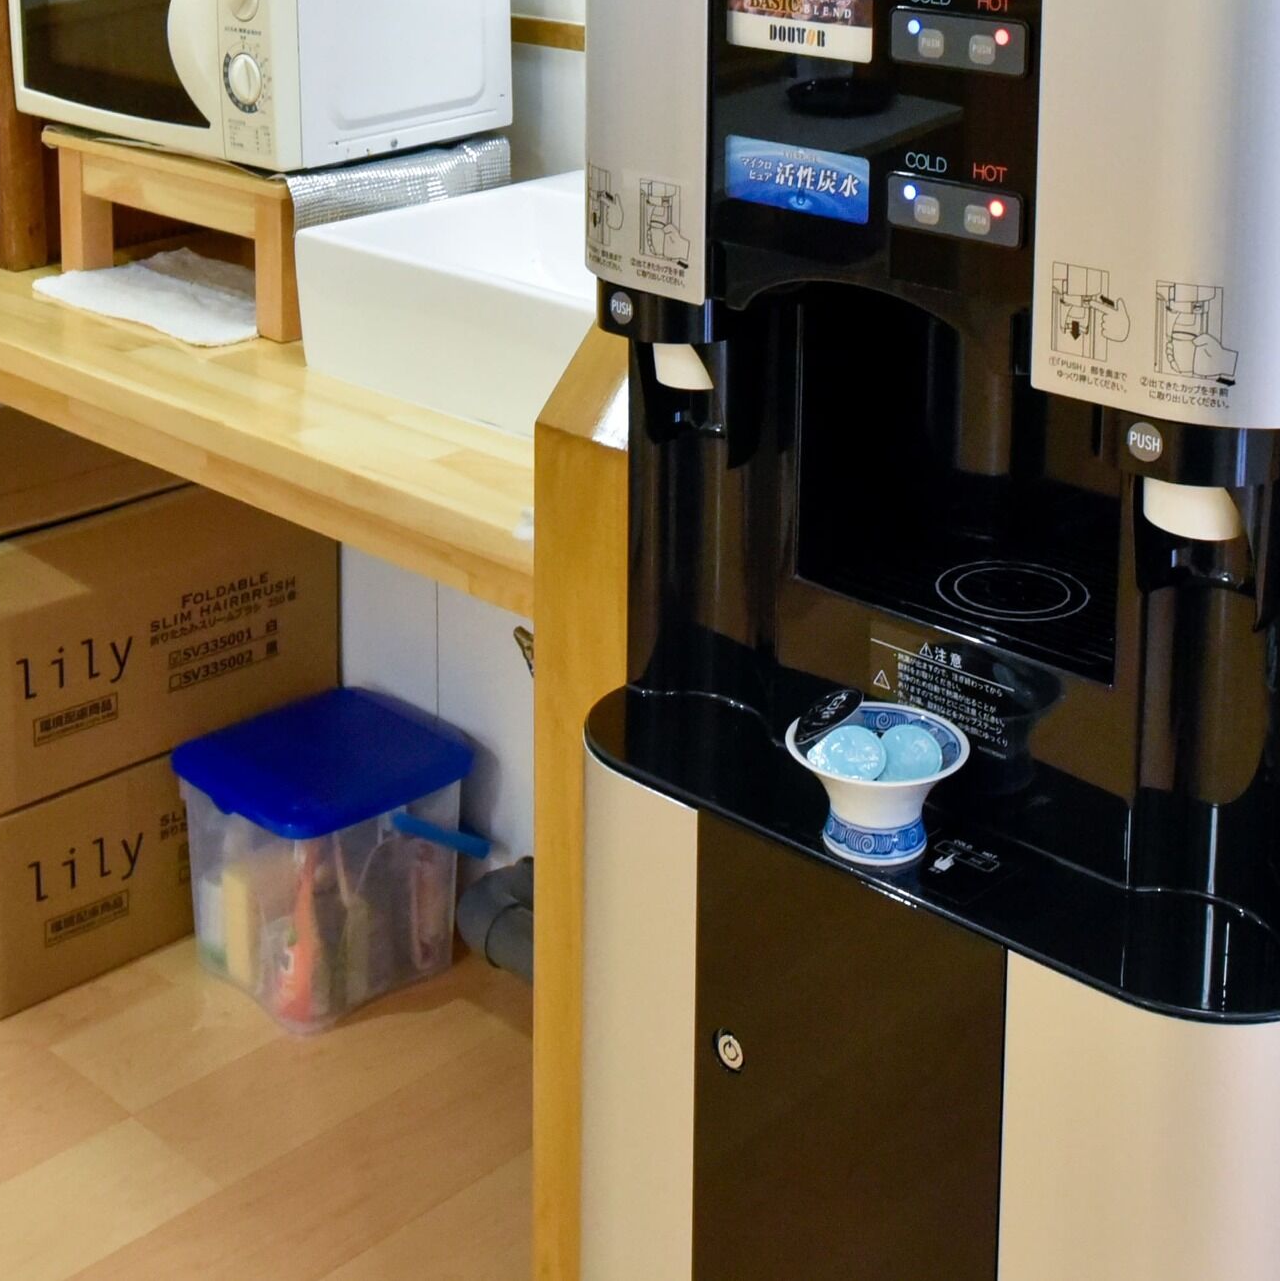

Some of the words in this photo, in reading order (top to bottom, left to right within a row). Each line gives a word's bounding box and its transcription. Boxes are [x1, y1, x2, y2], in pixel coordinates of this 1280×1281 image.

[803, 3, 852, 19] BLEND
[769, 23, 826, 48] DOUTOR
[921, 36, 941, 49] PUSH
[971, 43, 992, 56] PUSH
[740, 155, 773, 170] マイクロ
[905, 151, 948, 173] COLD
[972, 163, 1008, 183] HOT
[775, 161, 861, 198] 活性炭水
[916, 204, 937, 217] PUSH
[966, 212, 988, 226] PUSH
[610, 299, 632, 317] PUSH
[1129, 431, 1161, 454] PUSH
[181, 572, 269, 609] FOLDABLE
[150, 610, 192, 634] SLIM
[200, 576, 296, 618] HAIRBRUSH
[183, 627, 253, 660] SV335001
[934, 646, 962, 669] 注意
[16, 636, 133, 700] lily
[182, 649, 254, 684] SV335002
[28, 831, 144, 903] lily
